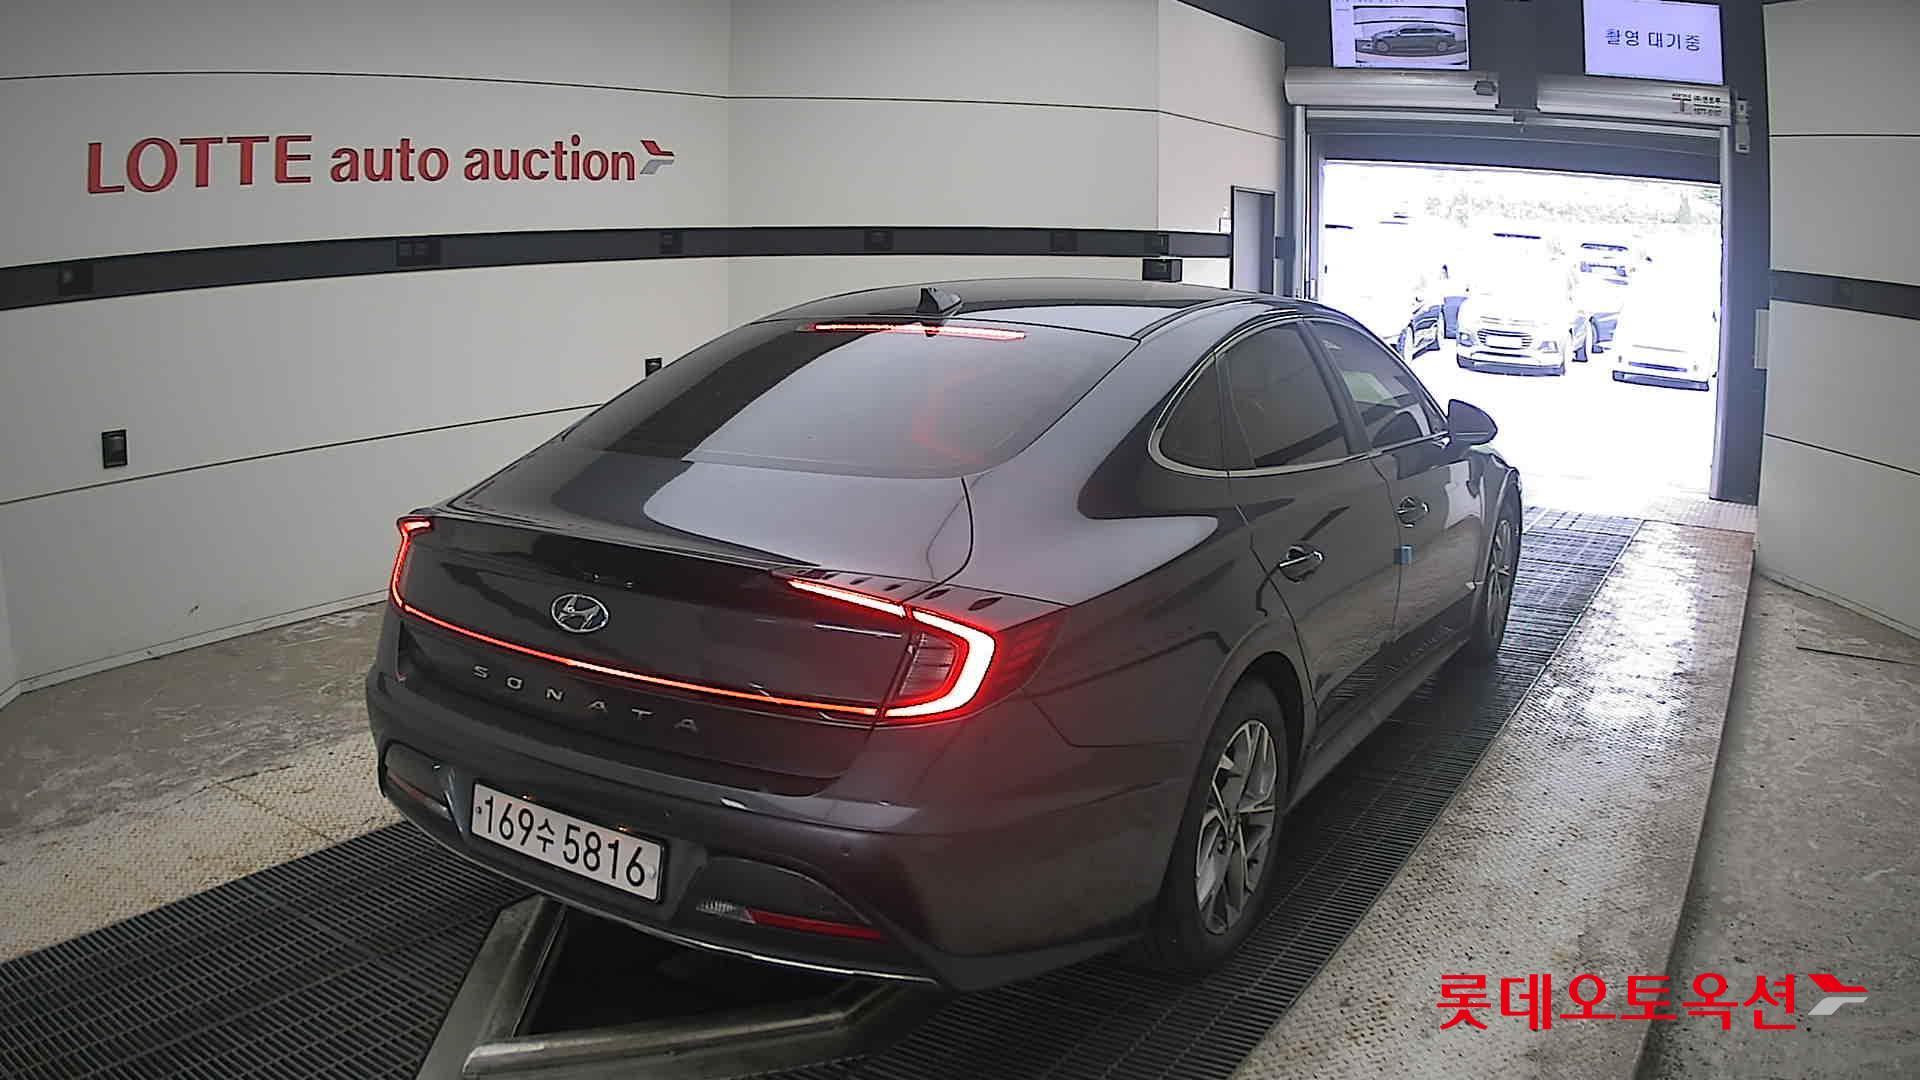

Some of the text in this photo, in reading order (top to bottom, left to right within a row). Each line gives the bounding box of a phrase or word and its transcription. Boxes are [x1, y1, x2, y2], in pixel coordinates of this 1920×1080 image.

[1648, 31, 1701, 52] 대기중
[87, 133, 636, 194] LOTTE auto auction
[472, 663, 698, 732] SONATA
